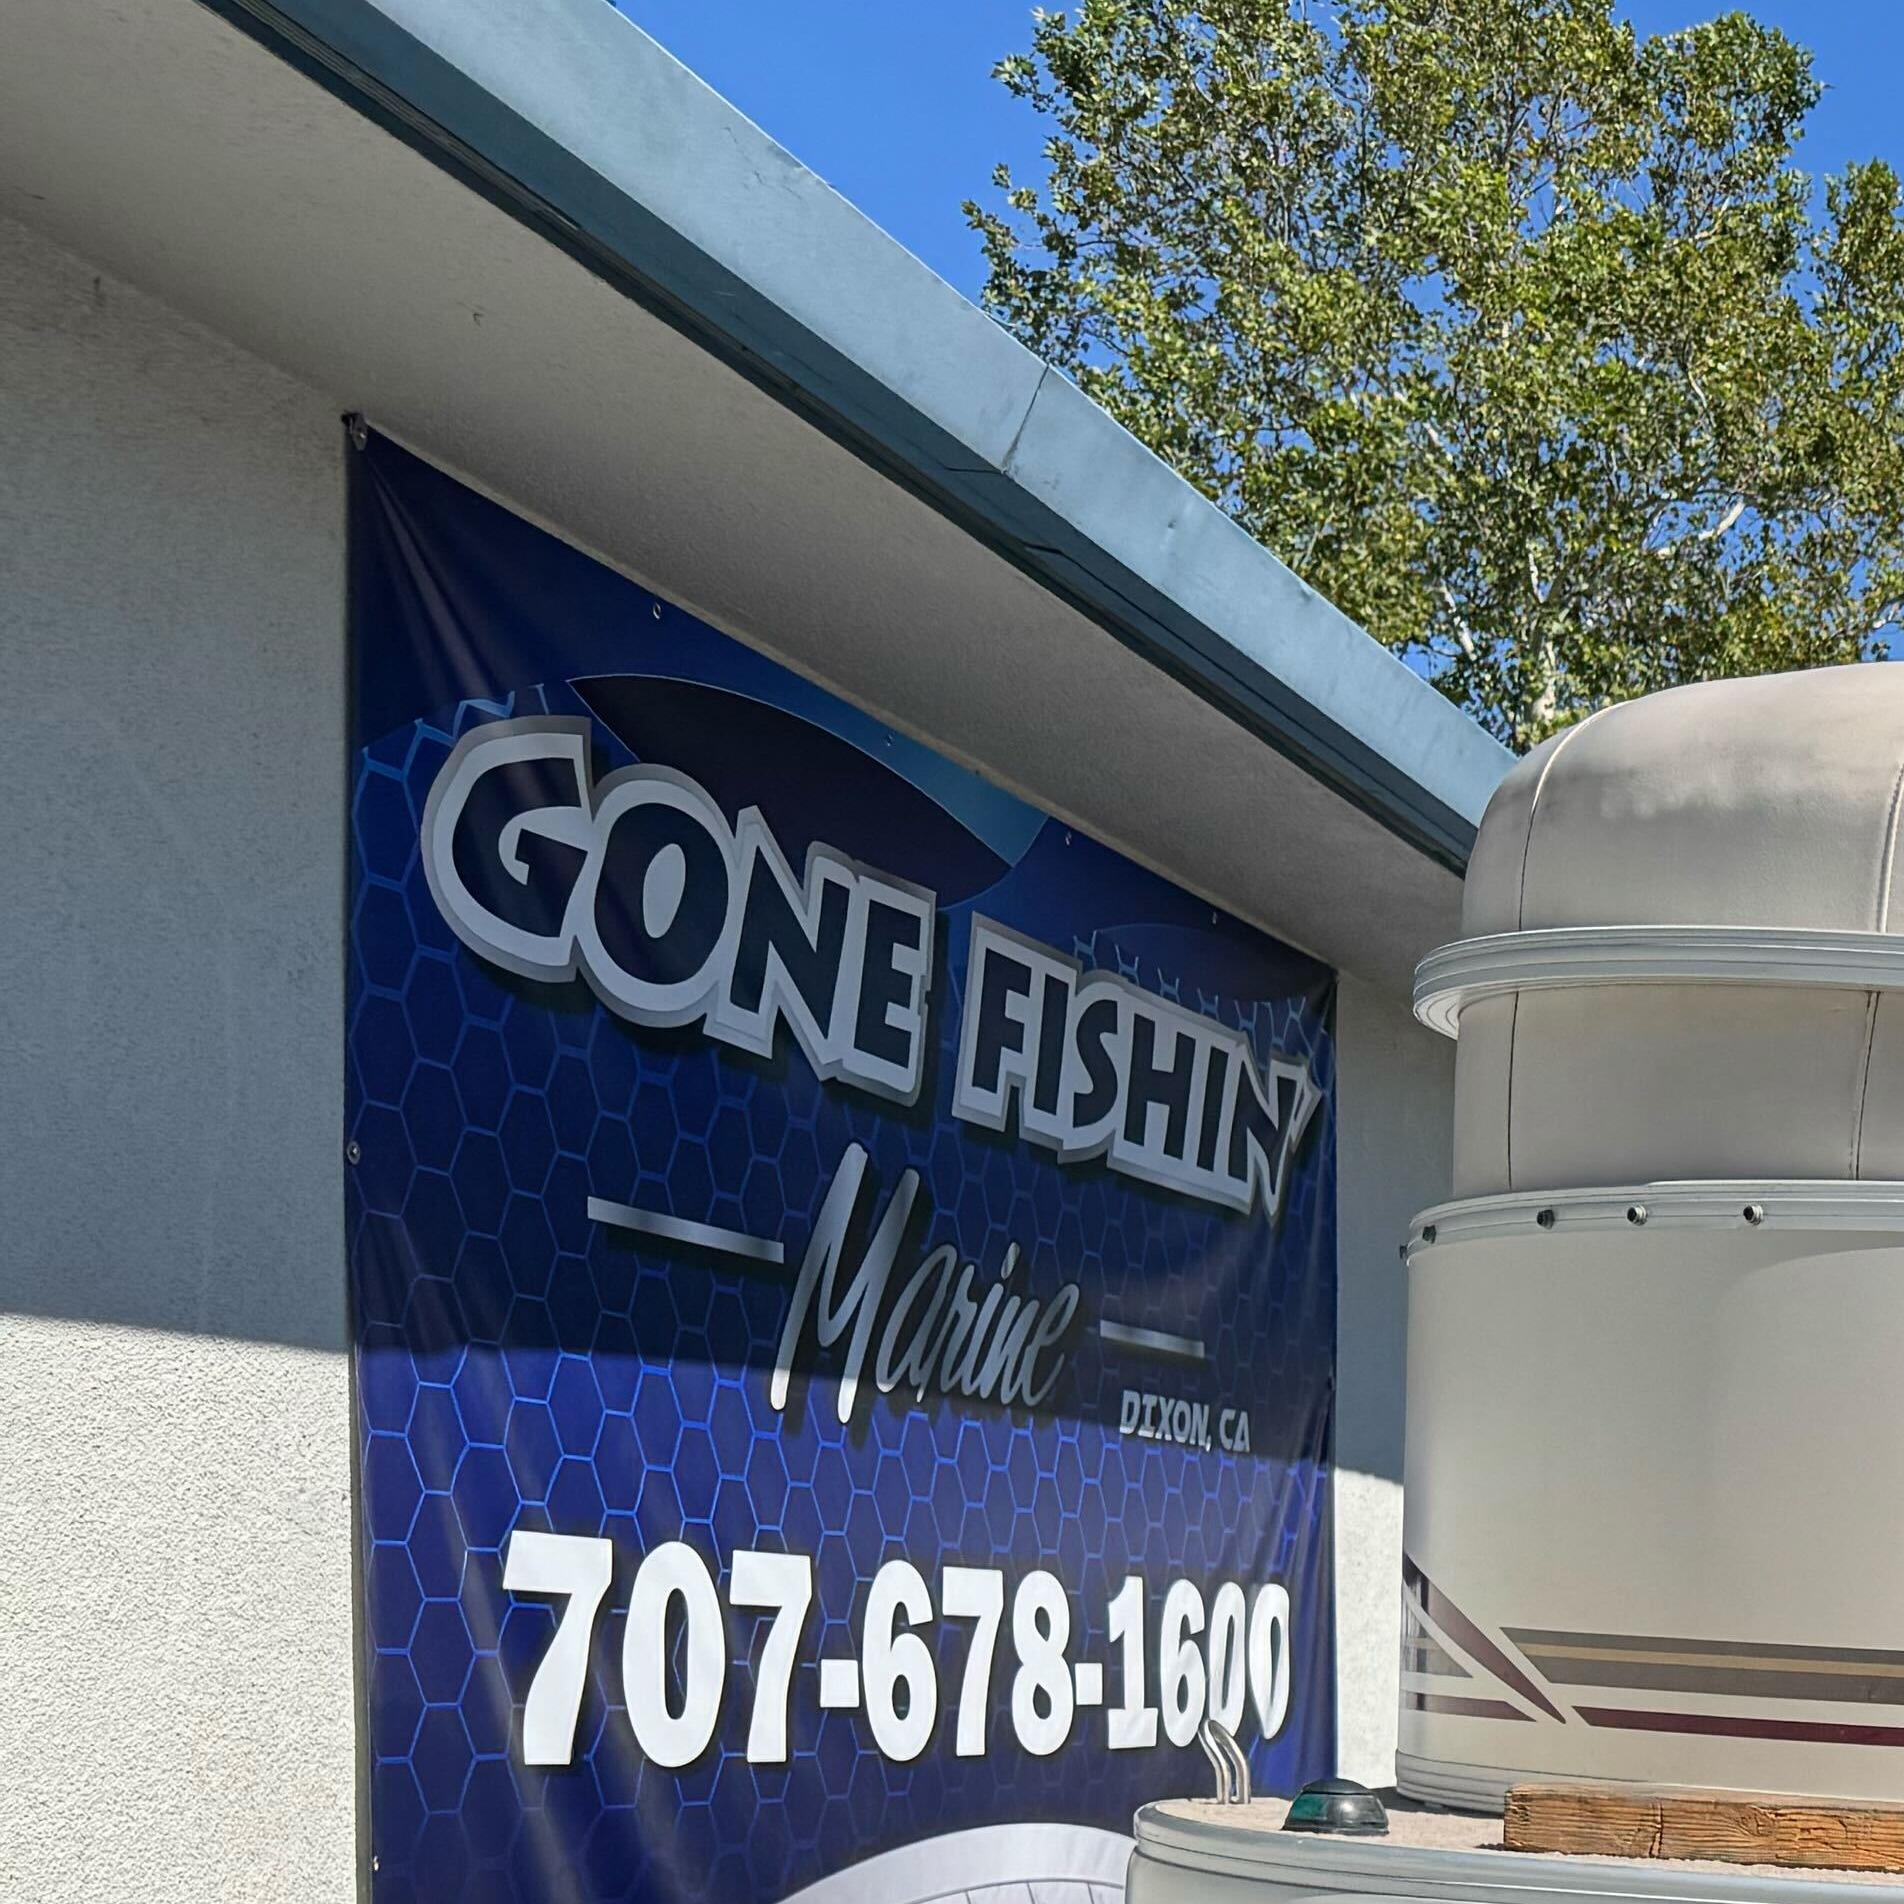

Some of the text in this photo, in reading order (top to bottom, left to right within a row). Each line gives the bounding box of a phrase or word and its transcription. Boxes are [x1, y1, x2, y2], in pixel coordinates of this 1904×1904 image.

[424, 718, 936, 1104] GONE
[771, 1142, 1079, 1423] Marine
[1119, 1390, 1250, 1453] DIXON, CA
[503, 1531, 1289, 1767] 707-678-1600
